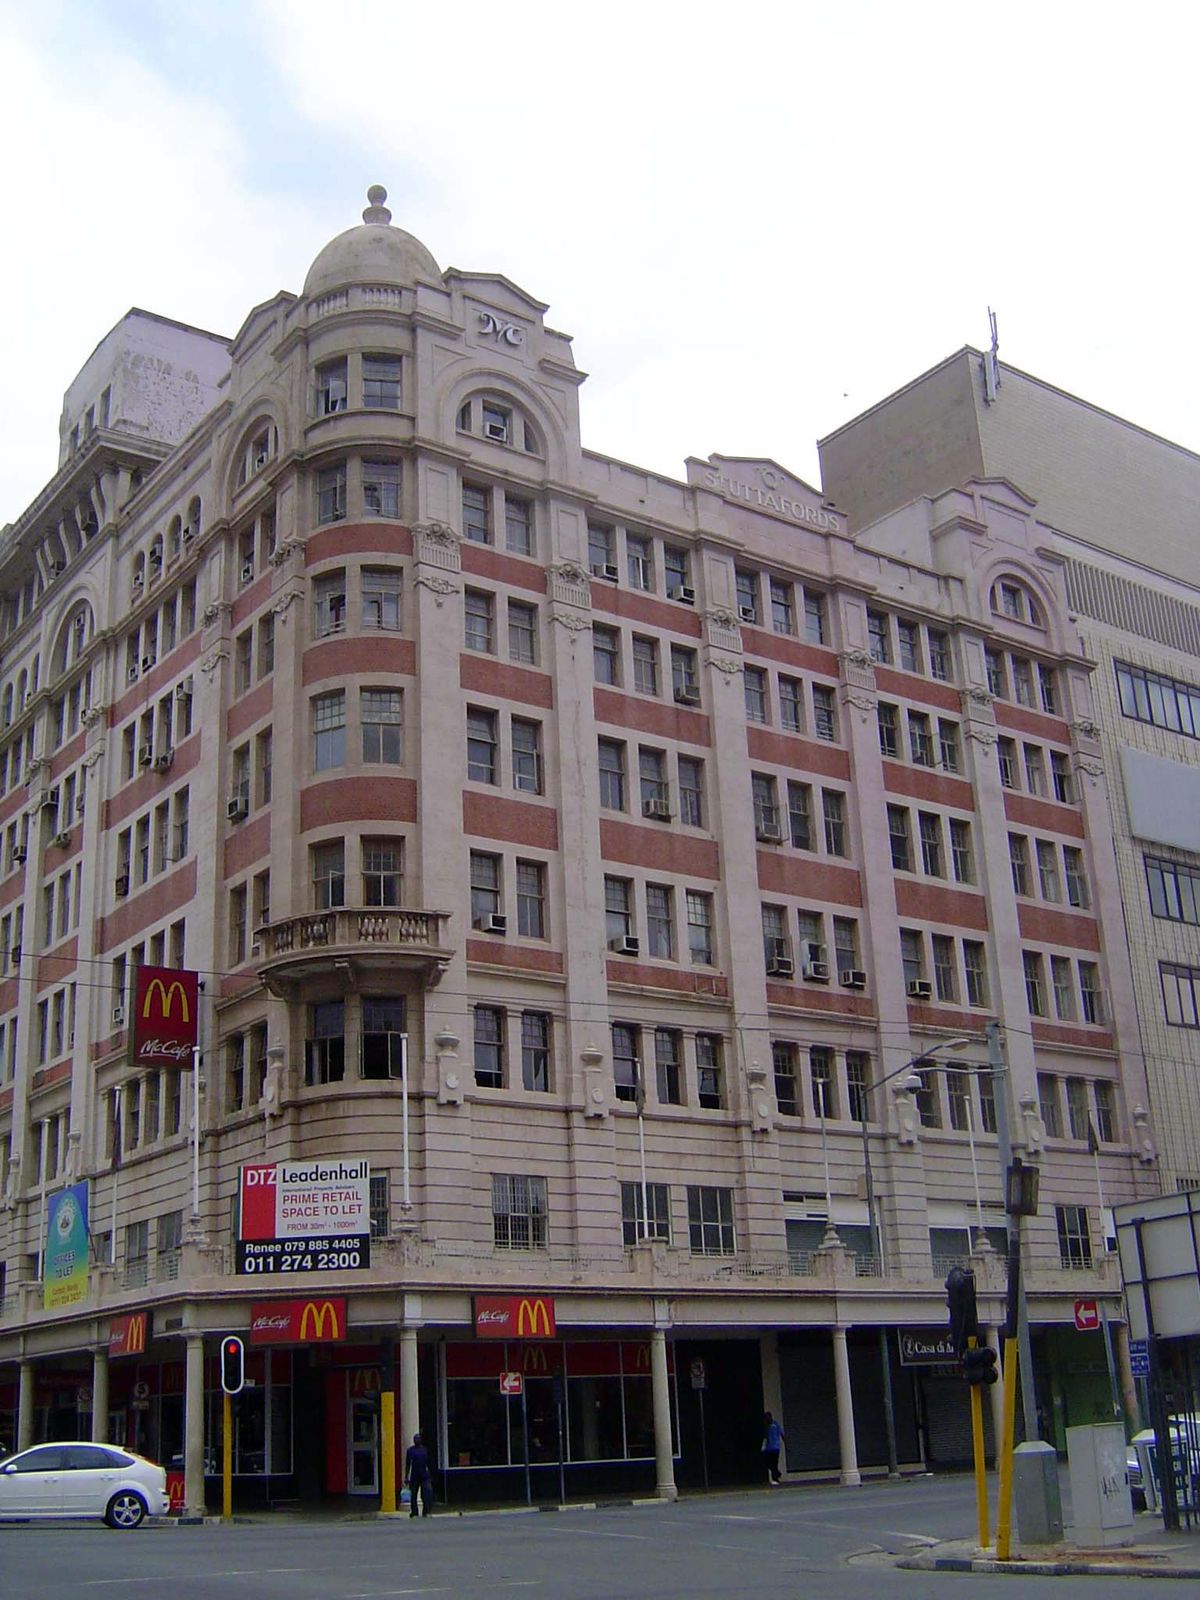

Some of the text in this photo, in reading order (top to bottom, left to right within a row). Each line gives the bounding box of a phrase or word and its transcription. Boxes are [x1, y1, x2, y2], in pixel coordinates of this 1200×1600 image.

[704, 471, 840, 530] STUTTAFORDS
[246, 1162, 368, 1186] DTZ Leadenhall
[283, 1190, 362, 1205] PRIME RETAIL
[282, 1204, 363, 1219] SPACE TO LET
[287, 1222, 309, 1232] FROM
[245, 1238, 361, 1255] Renee 079 885 4405
[244, 1252, 361, 1273] 011 274 2300
[63, 1265, 74, 1277] LET
[914, 1342, 935, 1353] Casa
